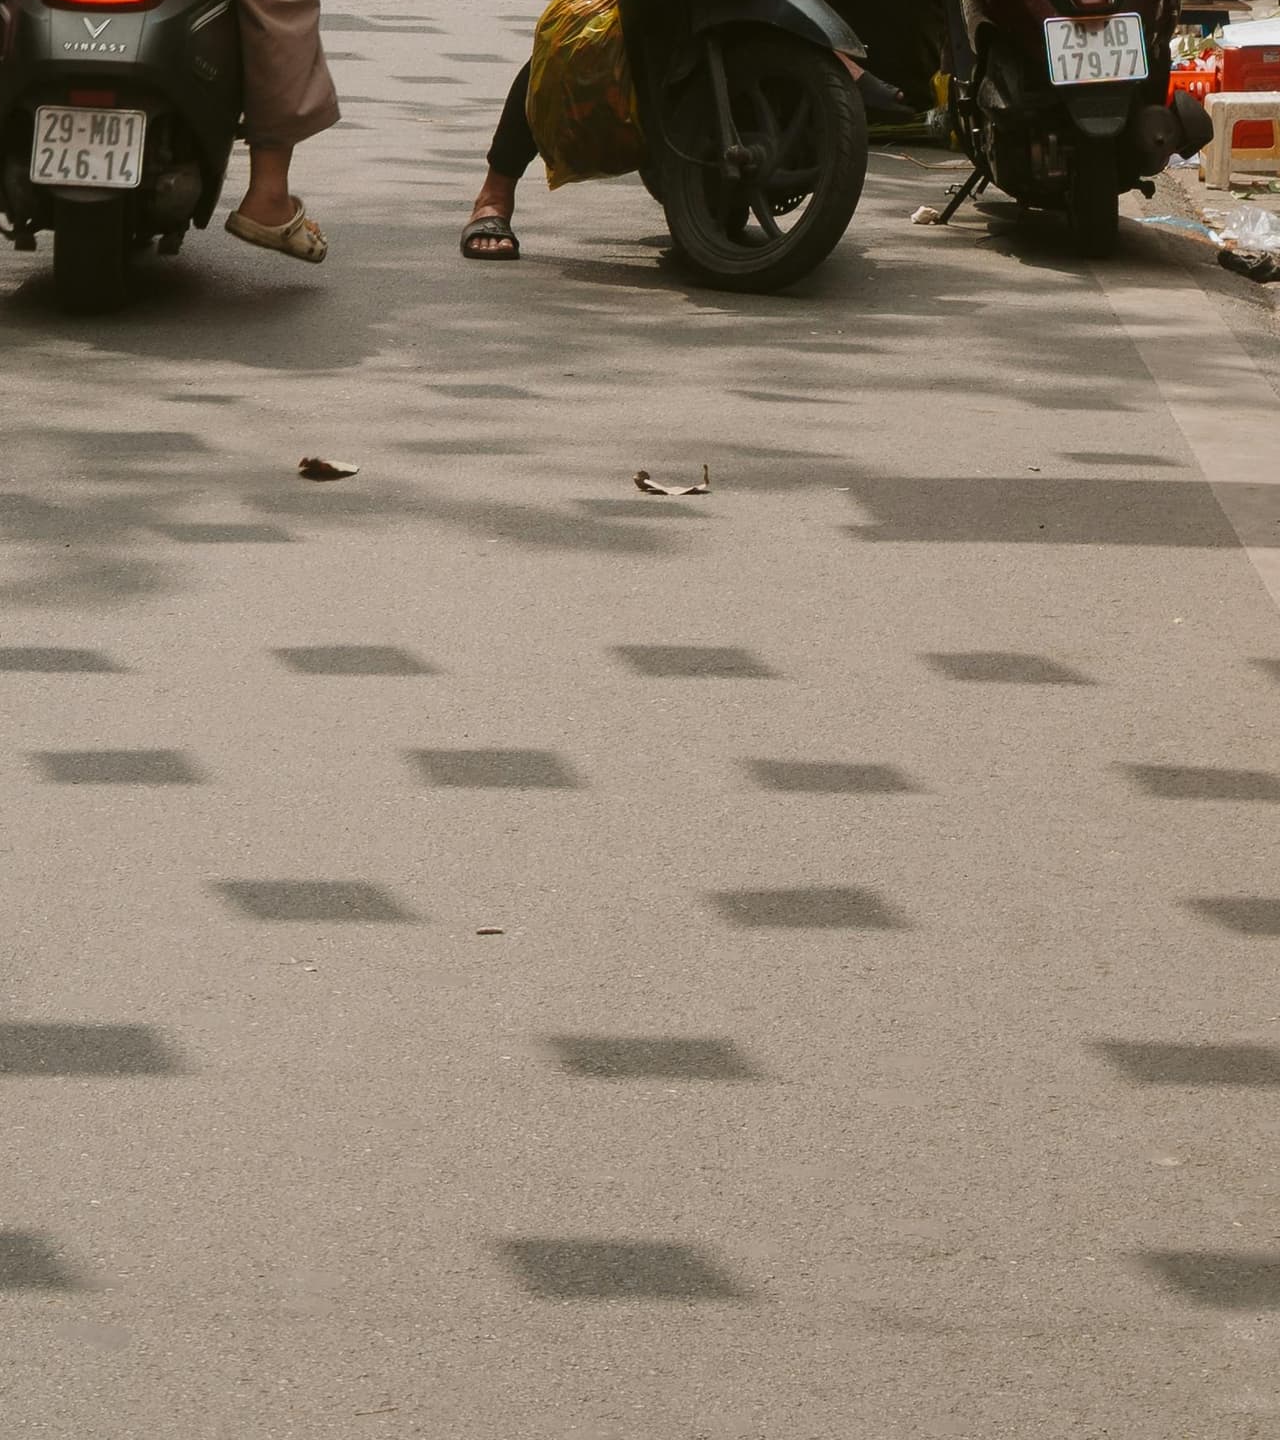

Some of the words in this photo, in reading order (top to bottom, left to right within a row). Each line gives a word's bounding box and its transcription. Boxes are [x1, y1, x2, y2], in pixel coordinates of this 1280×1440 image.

[64, 41, 128, 53] VINFAST
[1060, 19, 1130, 50] 29-AB
[1057, 49, 1139, 81] 179.77
[42, 113, 136, 148] 29-MD1
[39, 147, 133, 182] 246.14
